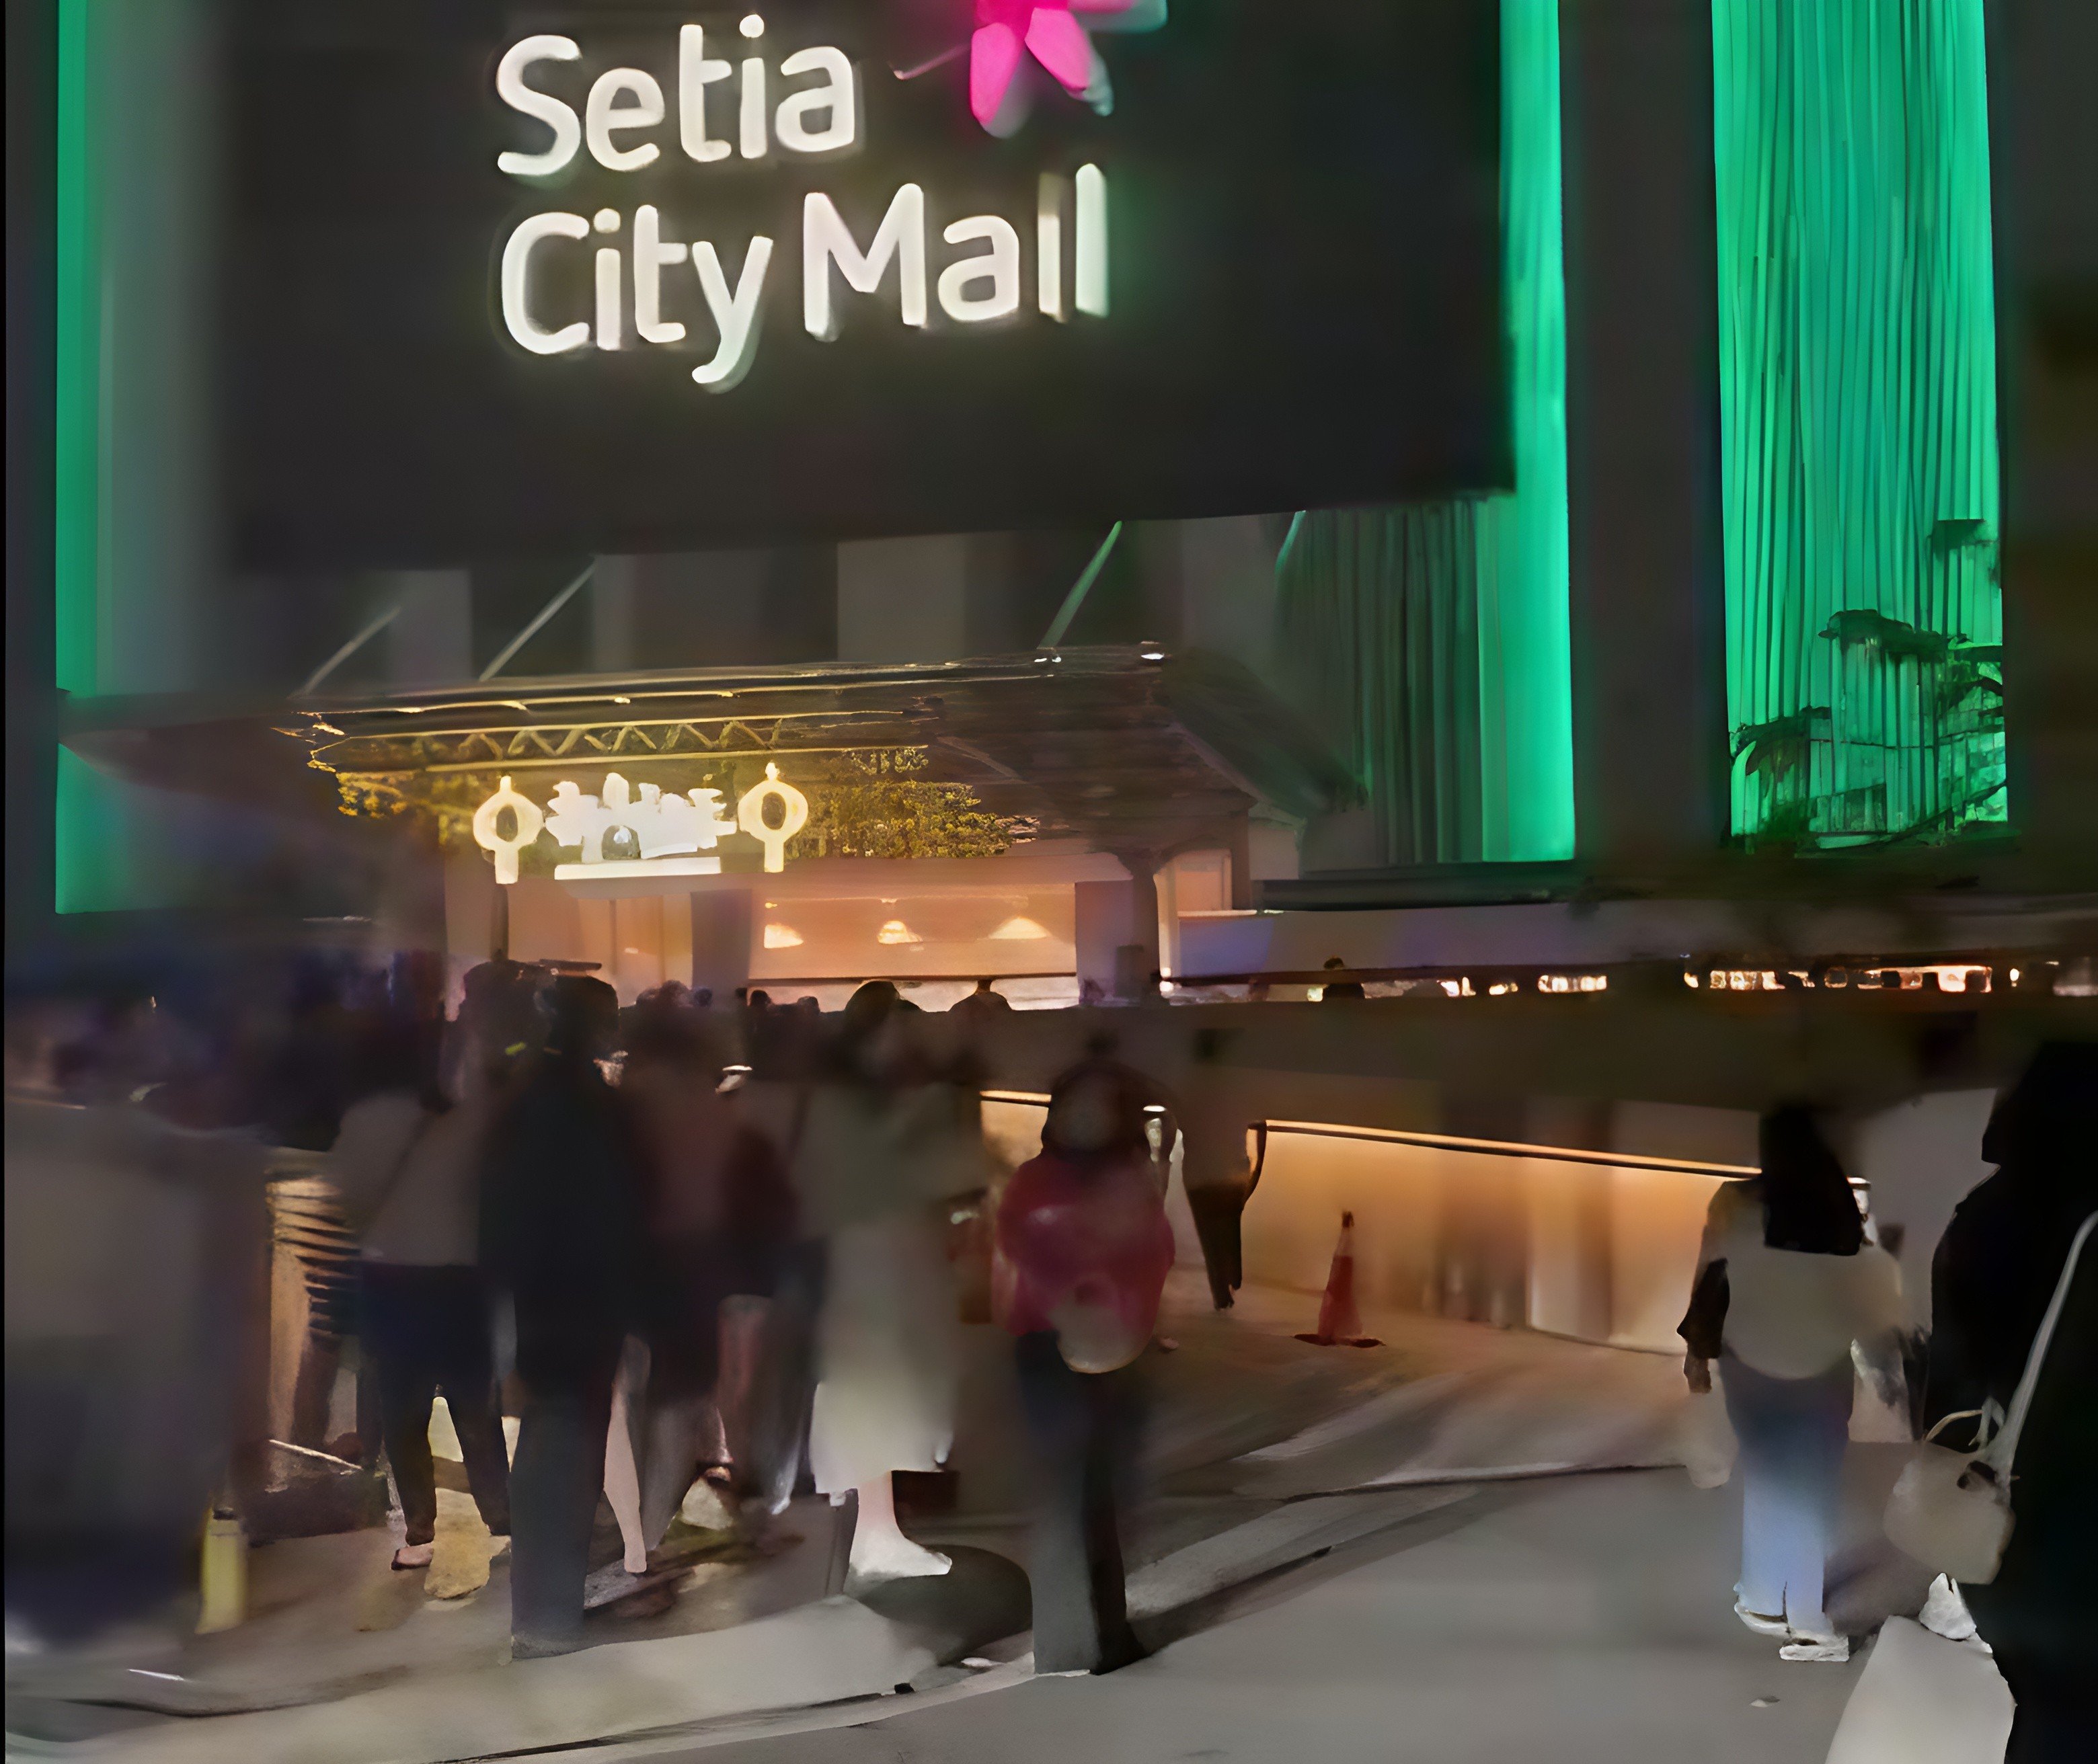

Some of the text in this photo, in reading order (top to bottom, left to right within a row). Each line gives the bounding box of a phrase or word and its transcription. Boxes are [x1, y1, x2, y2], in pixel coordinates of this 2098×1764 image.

[496, 13, 859, 177] Setia
[501, 163, 1109, 388] City Mall
